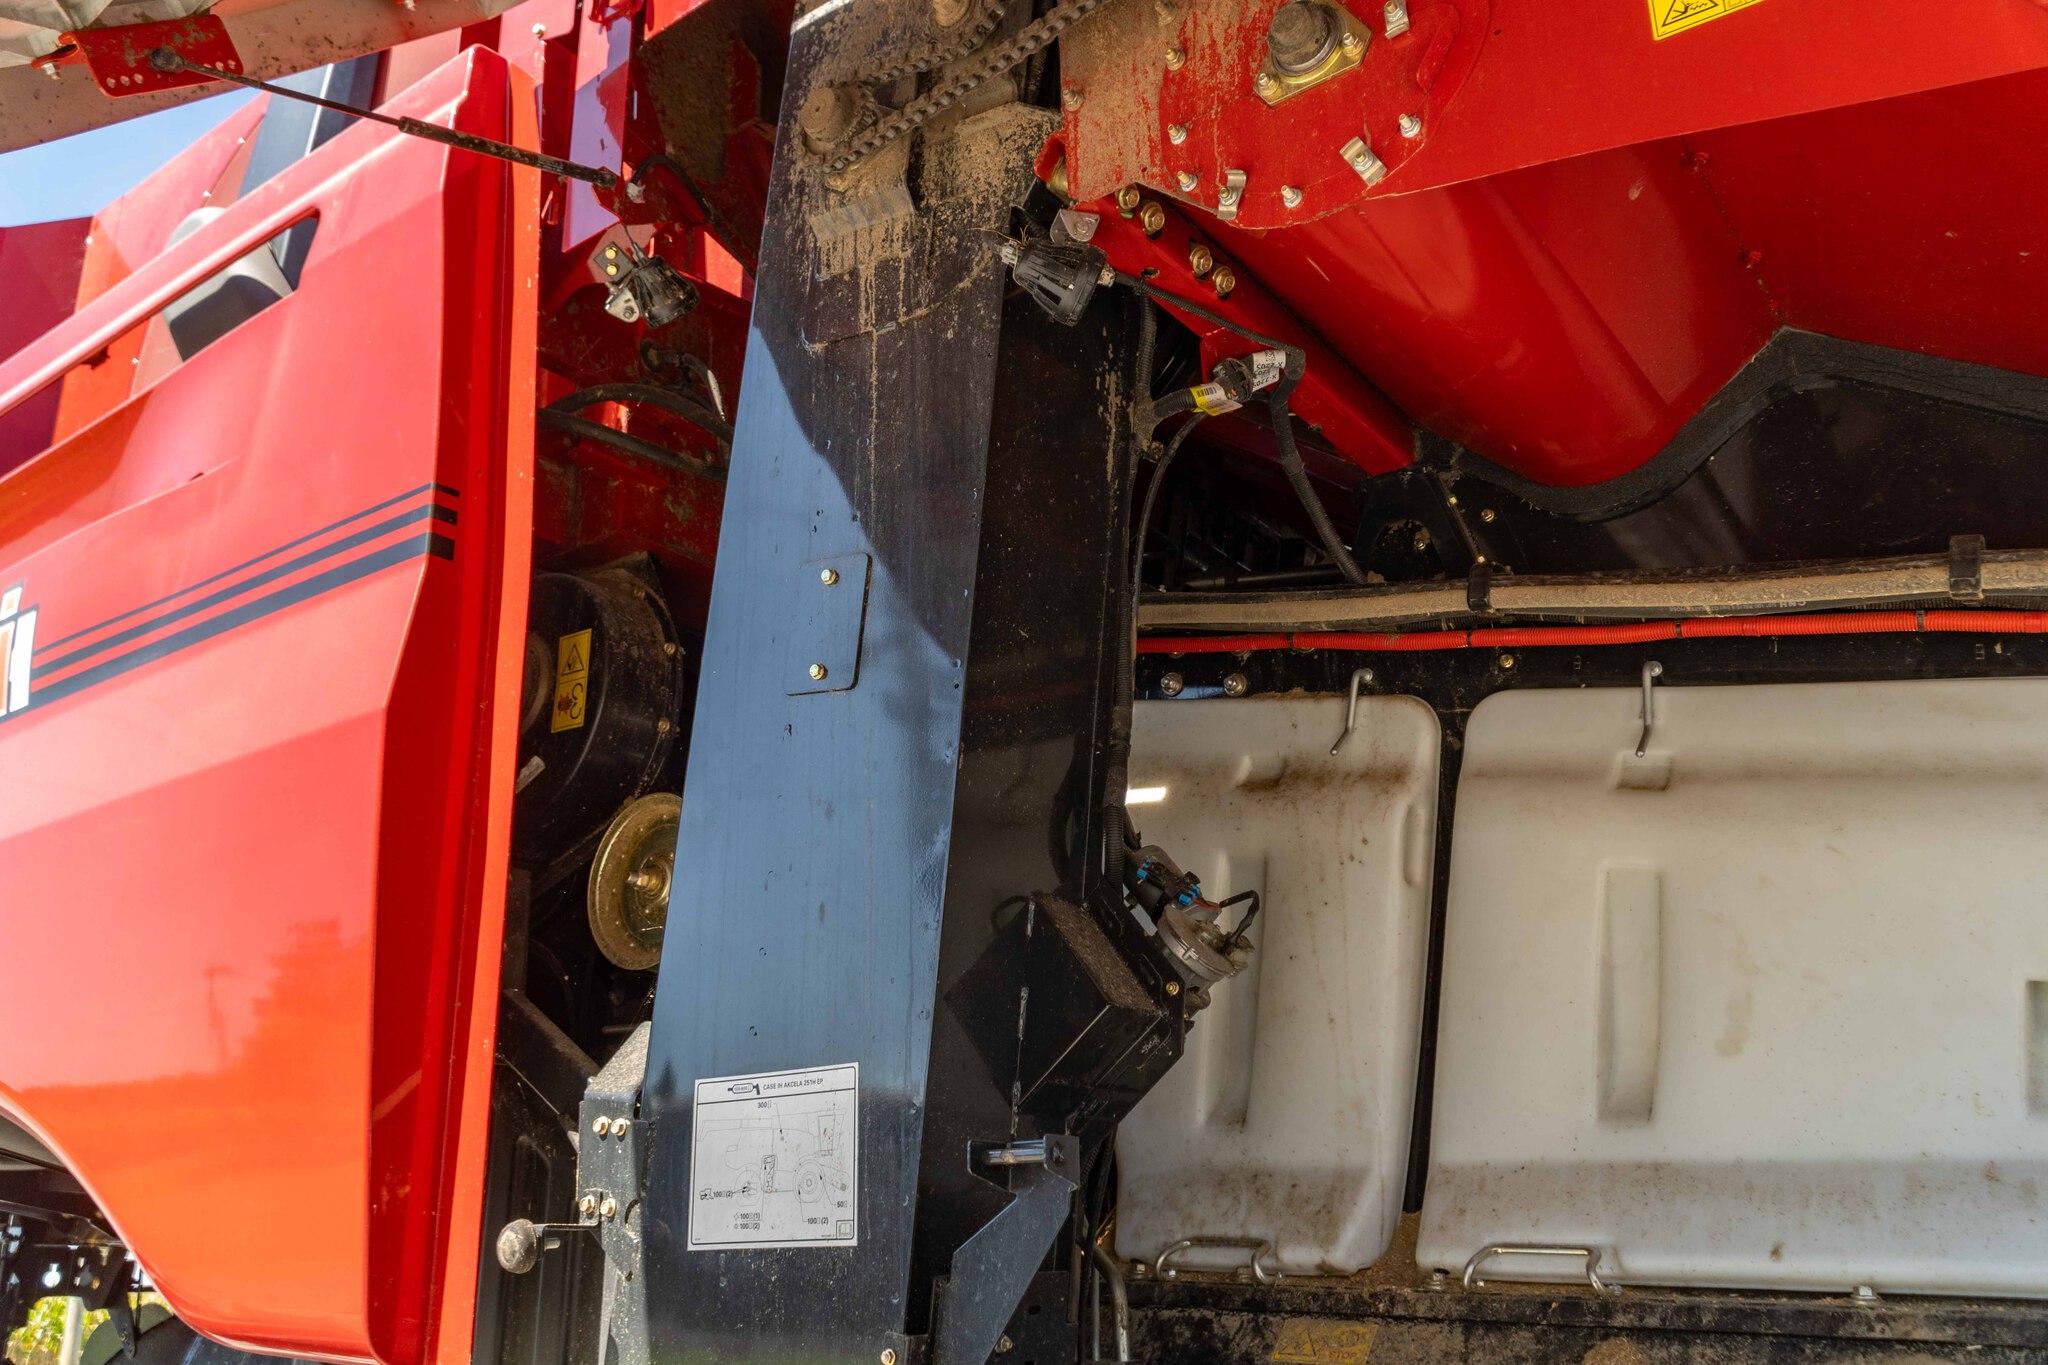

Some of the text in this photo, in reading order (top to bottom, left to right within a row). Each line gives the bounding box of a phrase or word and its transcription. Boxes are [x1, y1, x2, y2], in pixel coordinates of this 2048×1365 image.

[783, 1081, 803, 1089] AKCELA
[713, 1190, 722, 1198] 100
[740, 1212, 761, 1221] 100 (1)
[807, 1217, 817, 1225] 100
[739, 1222, 749, 1230] 100
[1329, 1350, 1358, 1359] STOP
